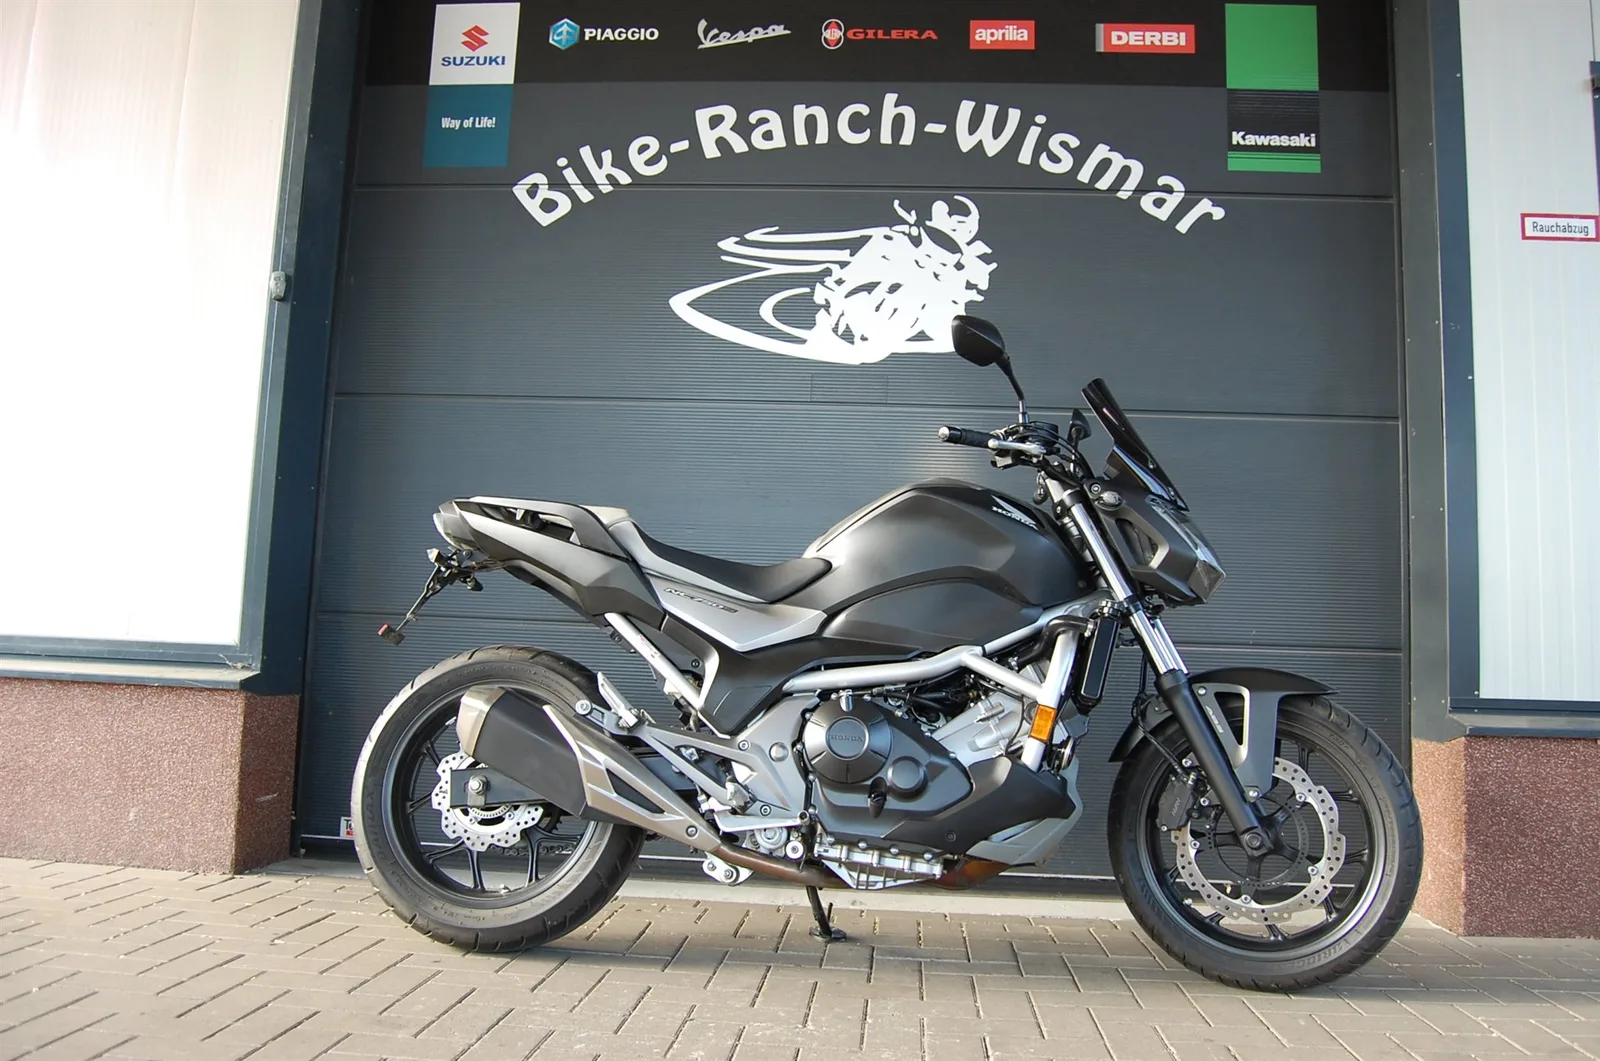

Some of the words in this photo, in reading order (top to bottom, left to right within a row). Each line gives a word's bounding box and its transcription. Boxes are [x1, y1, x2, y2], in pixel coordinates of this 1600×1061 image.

[584, 27, 660, 41] PIAGGIO
[697, 18, 791, 50] Vespa
[846, 28, 939, 40] GILERA
[974, 25, 1029, 44] aprilia
[1110, 30, 1187, 46] DERBI
[441, 55, 506, 67] SUZUKI
[441, 117, 461, 131] Way
[463, 116, 474, 128] of
[475, 116, 496, 128] Life!
[1231, 131, 1316, 147] Kawasaki
[511, 92, 1226, 235] Bike-Ranch-Wismar
[1532, 221, 1590, 237] Rauchabzug
